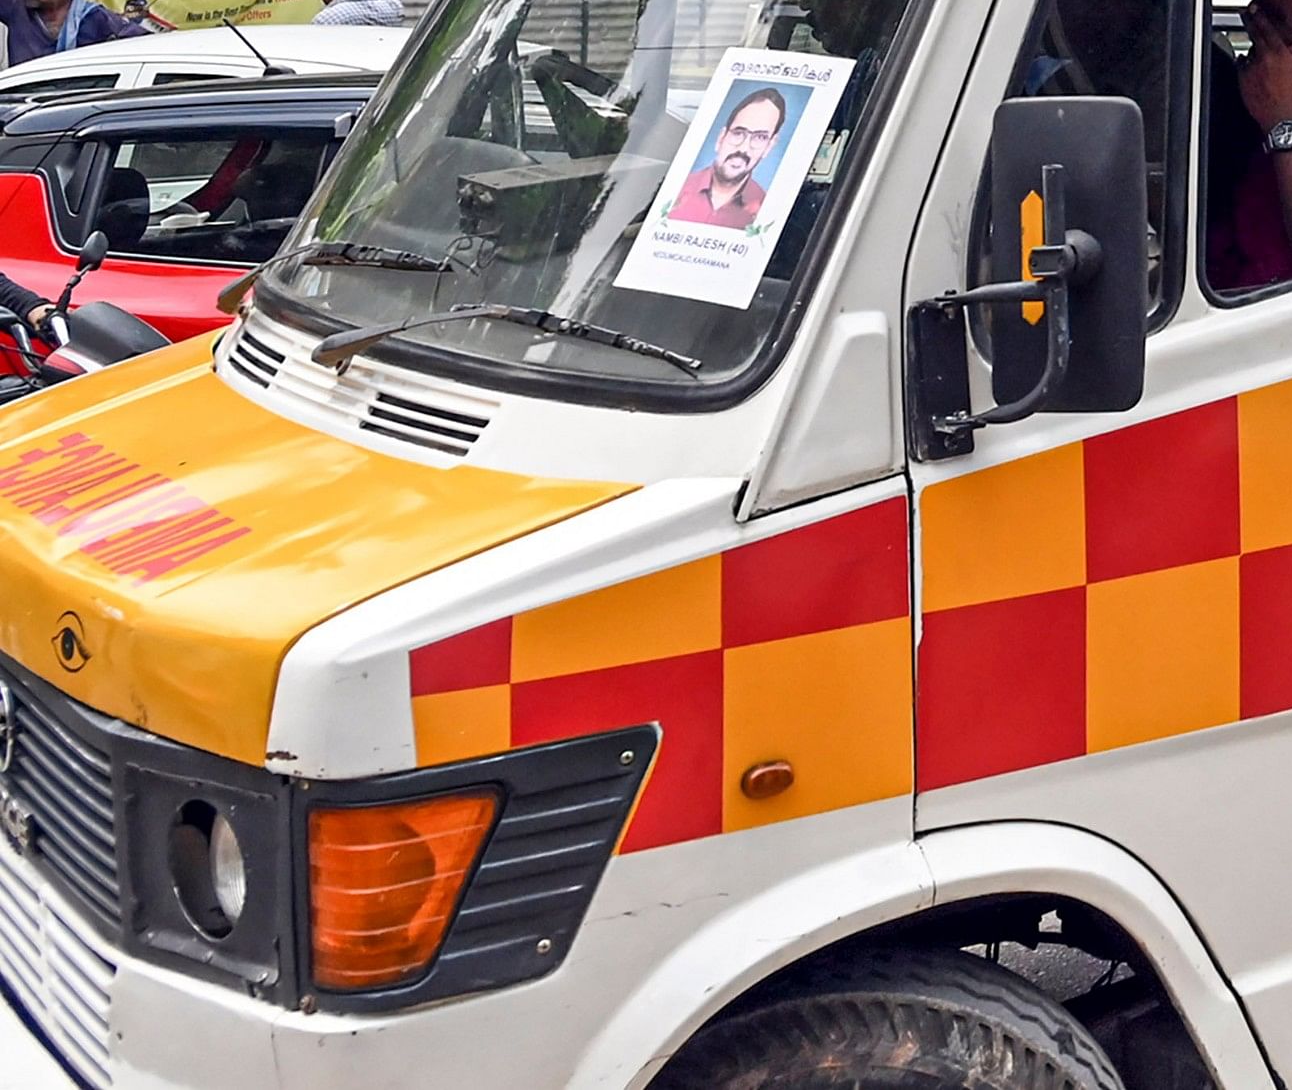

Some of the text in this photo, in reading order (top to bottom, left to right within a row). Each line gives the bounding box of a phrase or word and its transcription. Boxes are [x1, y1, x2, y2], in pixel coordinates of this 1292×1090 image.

[186, 12, 203, 22] Now
[246, 10, 272, 21] Offers
[652, 230, 749, 258] NAMBI RAJESH (40)
